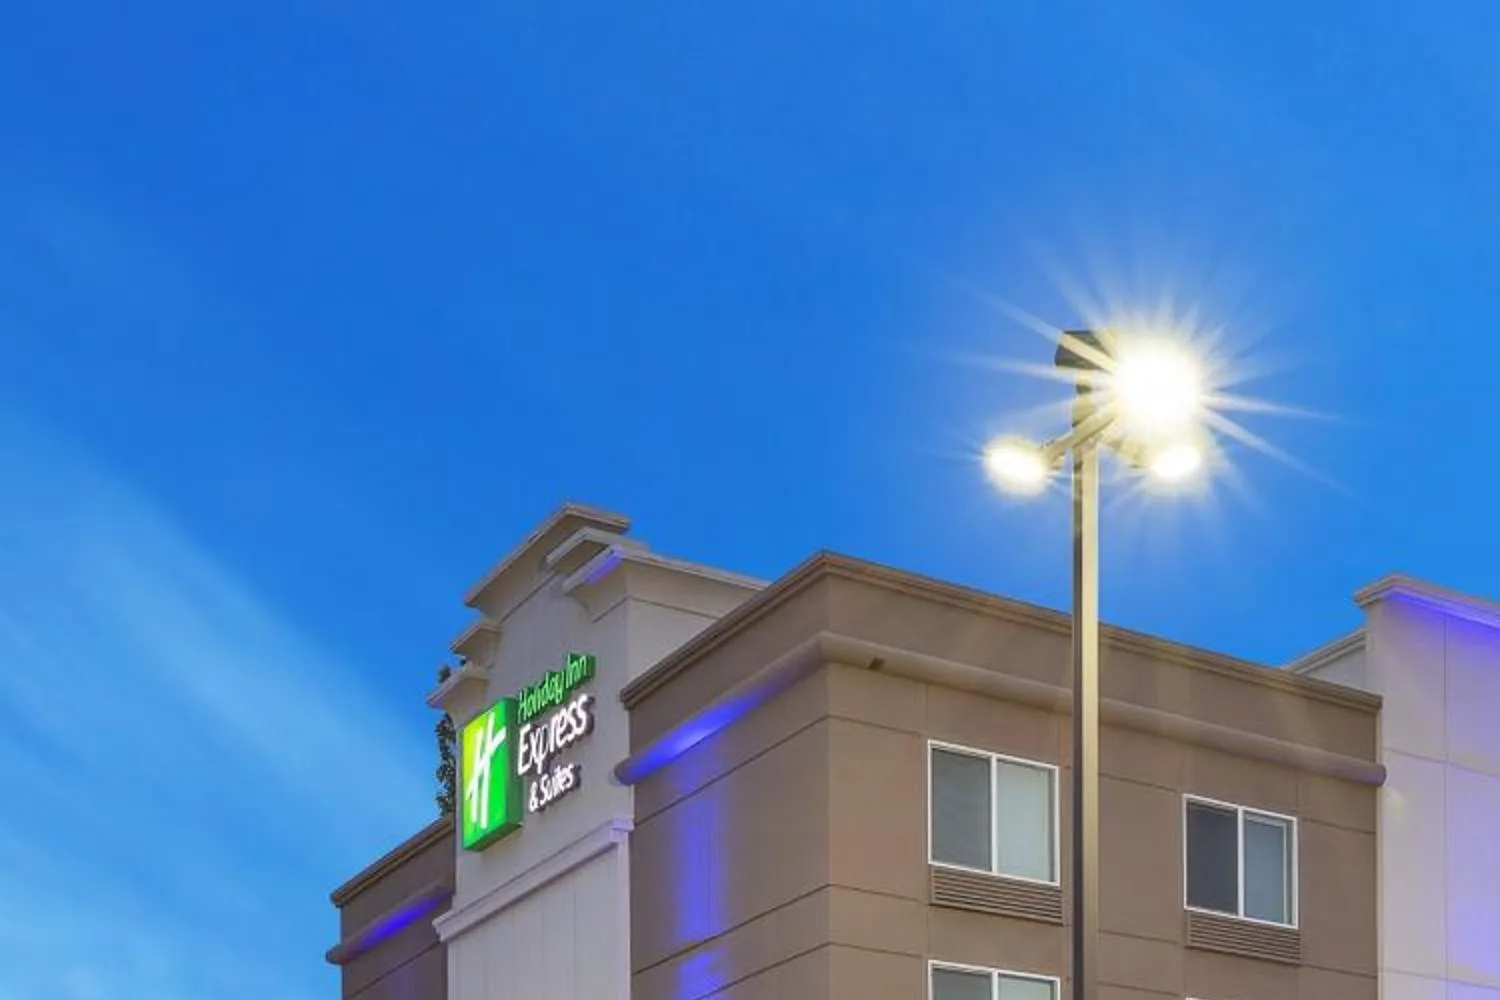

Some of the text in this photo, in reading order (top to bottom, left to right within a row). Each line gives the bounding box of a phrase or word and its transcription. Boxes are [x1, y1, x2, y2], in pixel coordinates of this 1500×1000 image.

[517, 653, 588, 723] Holiday Inn
[517, 693, 589, 776] Express
[529, 762, 575, 812] & Suites
